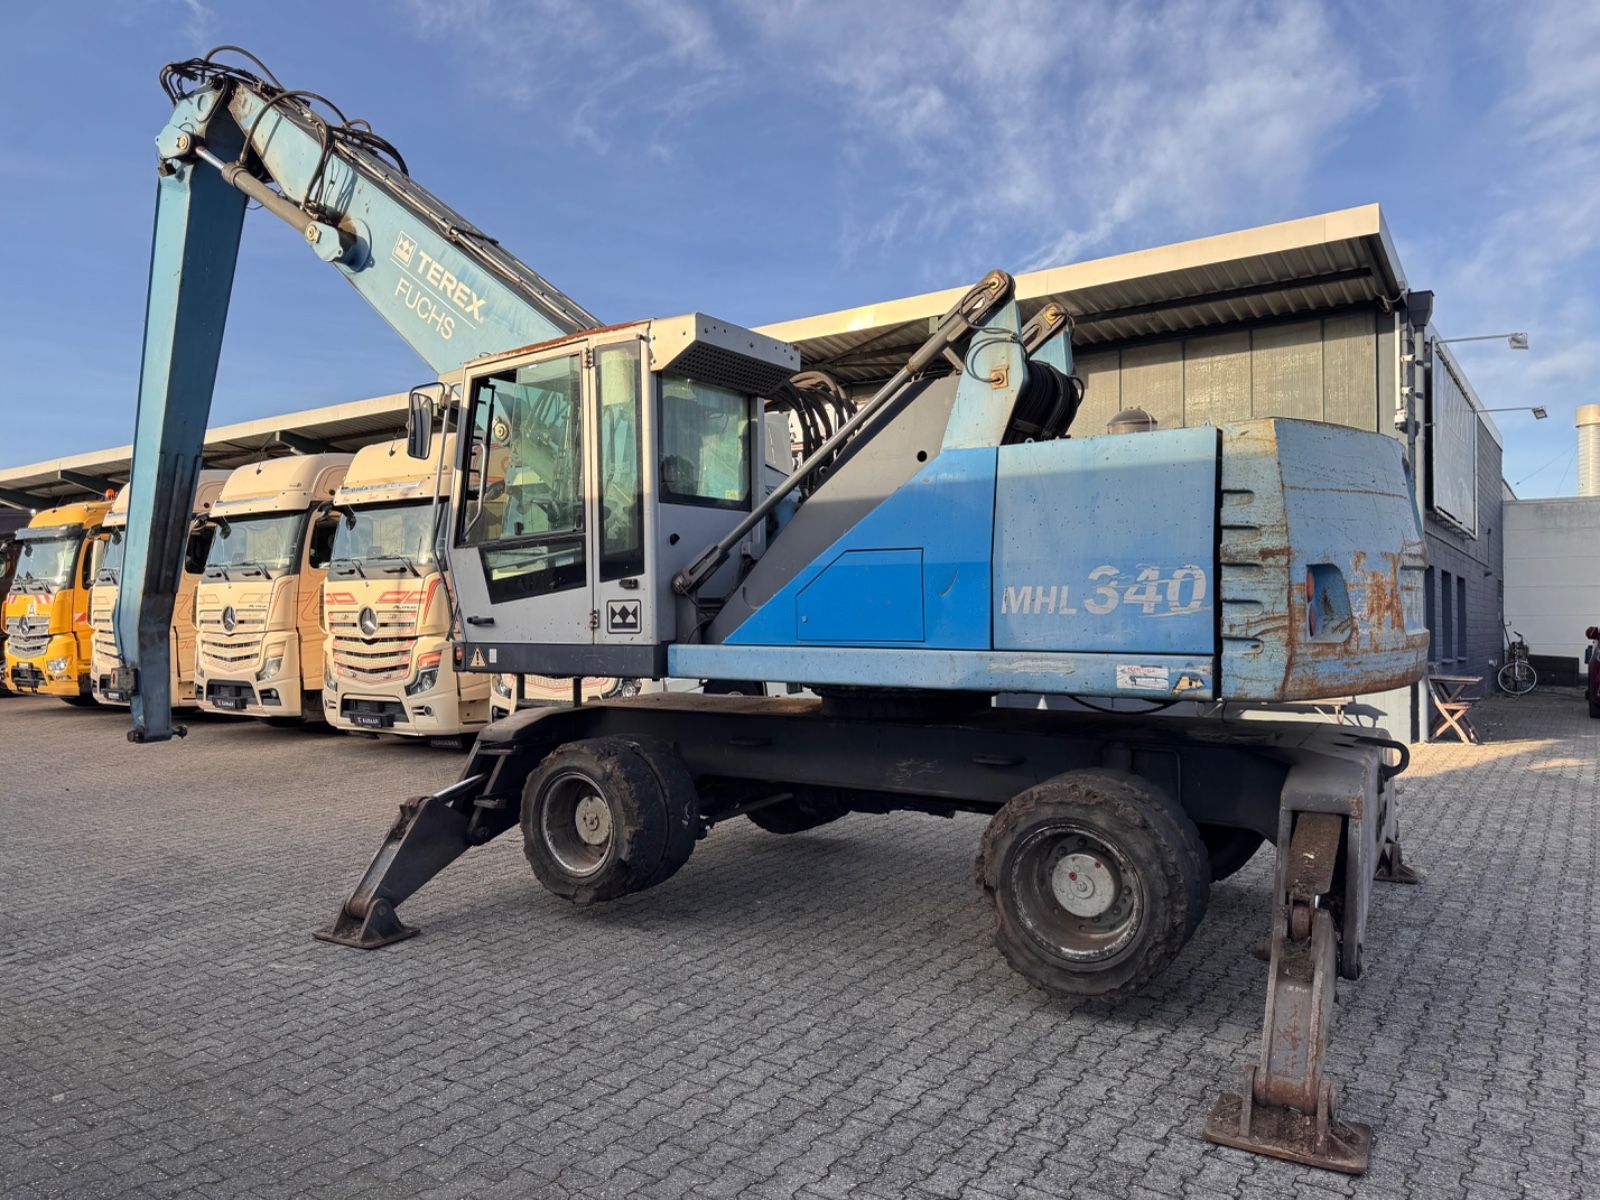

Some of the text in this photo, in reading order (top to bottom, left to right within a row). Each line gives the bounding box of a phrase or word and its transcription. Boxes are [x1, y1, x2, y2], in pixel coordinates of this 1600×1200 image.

[395, 278, 455, 339] FUCHS
[418, 250, 486, 321] TEREX
[1001, 564, 1207, 614] MHL 340
